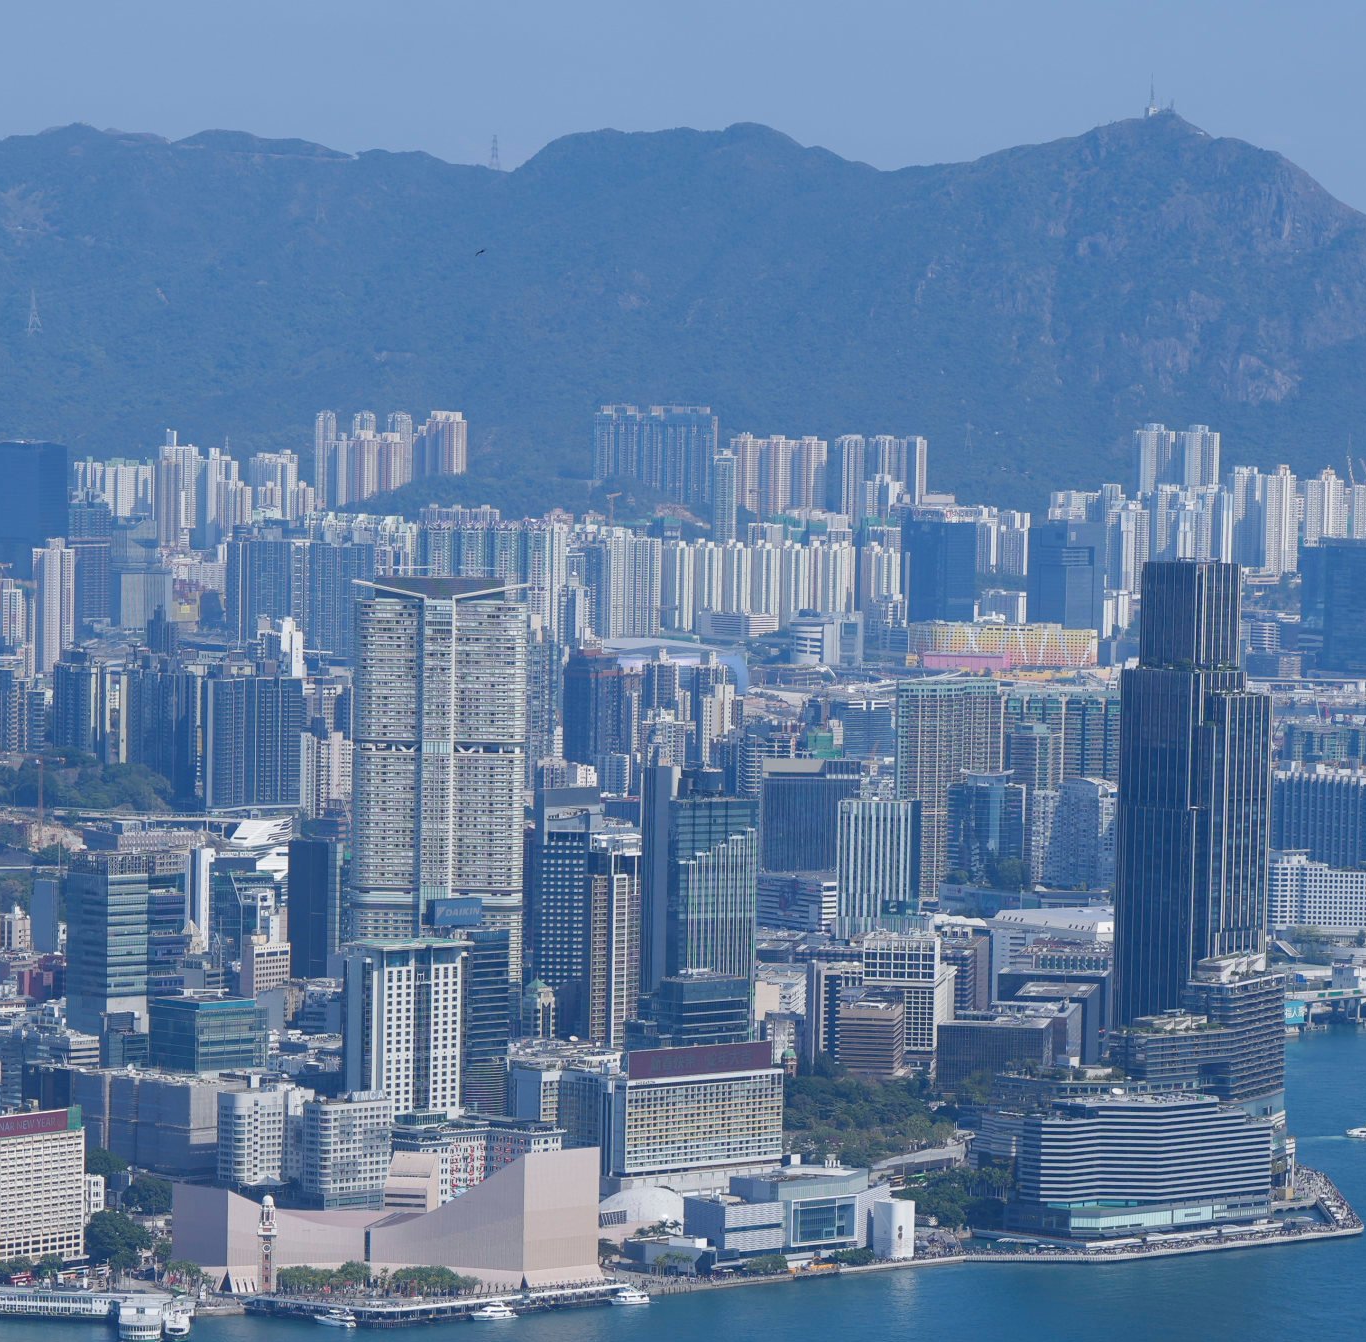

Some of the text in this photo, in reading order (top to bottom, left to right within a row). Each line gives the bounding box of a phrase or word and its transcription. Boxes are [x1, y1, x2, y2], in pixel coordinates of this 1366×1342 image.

[445, 906, 481, 917] DAIKIN
[352, 1090, 384, 1102] YMCA
[15, 1119, 35, 1131] NEW
[36, 1116, 57, 1129] YEAR
